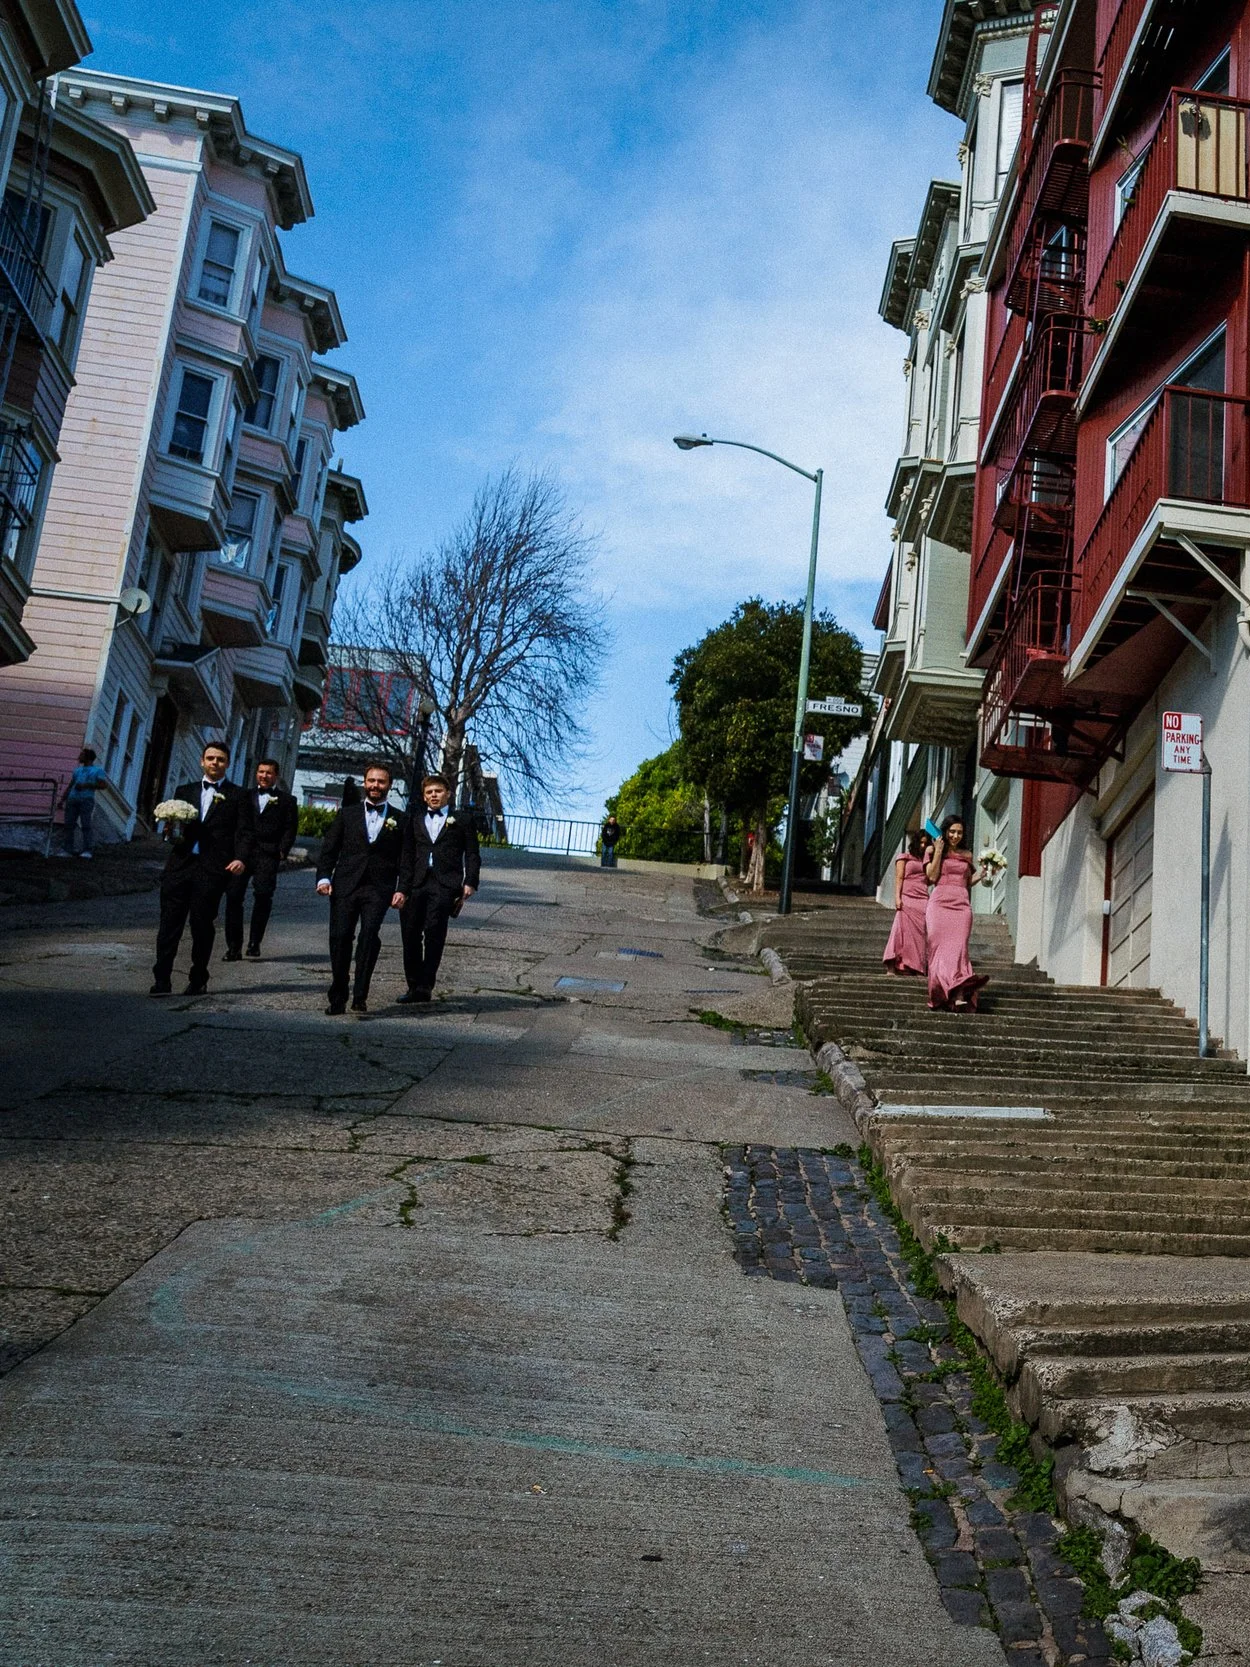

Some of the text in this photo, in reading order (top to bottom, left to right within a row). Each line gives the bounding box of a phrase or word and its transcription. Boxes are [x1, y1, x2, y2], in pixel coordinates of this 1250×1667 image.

[812, 703, 859, 714] FRESNO
[1165, 714, 1179, 728] NO
[1166, 732, 1200, 745] PARKING
[1173, 745, 1190, 754] ANY
[1173, 755, 1192, 764] TIME
